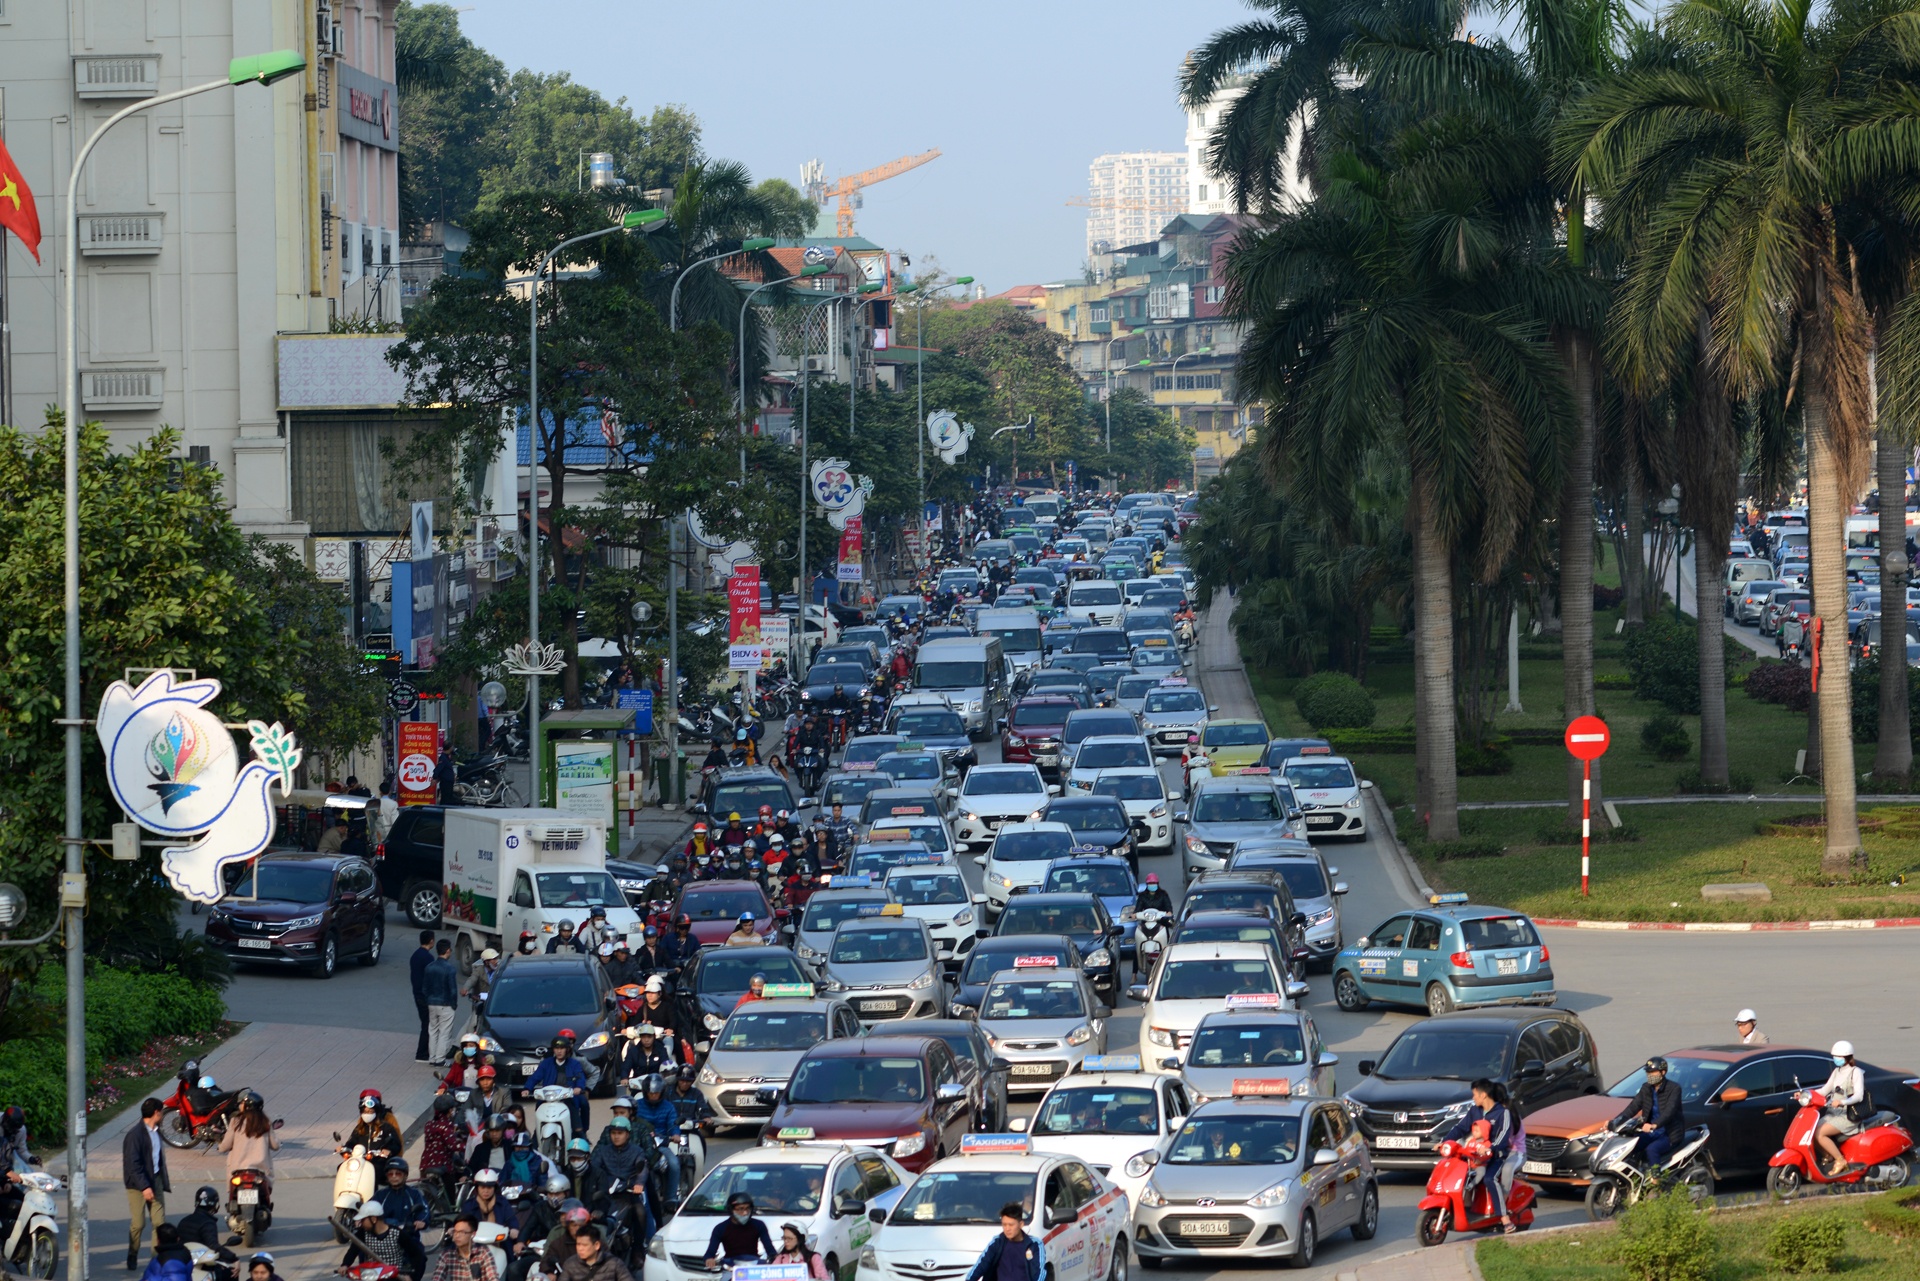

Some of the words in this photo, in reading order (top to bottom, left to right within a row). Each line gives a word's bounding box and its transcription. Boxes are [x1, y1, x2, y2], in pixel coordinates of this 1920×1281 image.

[507, 837, 518, 847] 15
[541, 840, 550, 851] XE
[781, 1127, 809, 1136] TAXI
[971, 1138, 1026, 1147] TAXIGROUP
[1376, 1136, 1419, 1148] 30E-321.64
[1181, 1222, 1229, 1235] 30A-803.49
